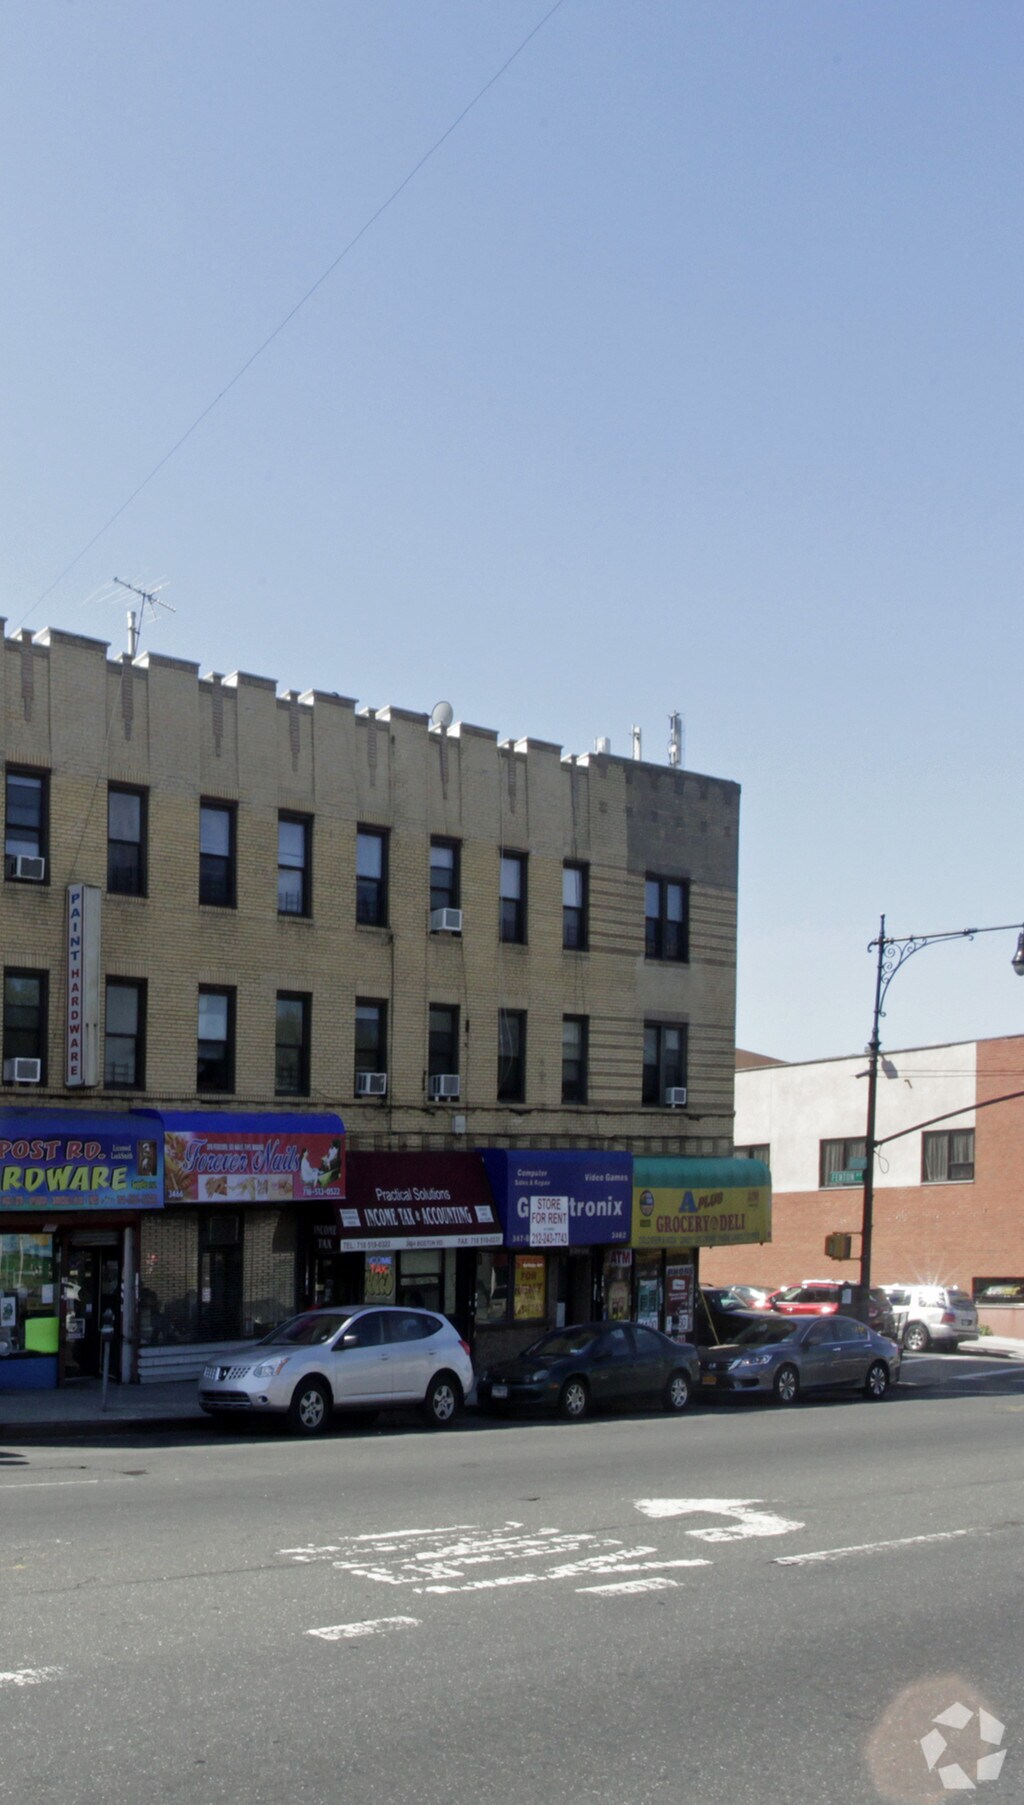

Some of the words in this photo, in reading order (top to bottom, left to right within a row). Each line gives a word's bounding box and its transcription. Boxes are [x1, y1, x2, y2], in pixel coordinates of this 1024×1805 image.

[70, 893, 80, 961] PAINT
[70, 969, 80, 1076] HARDWARE
[66, 1140, 106, 1160] RD.
[182, 1138, 248, 1173] Forever
[252, 1138, 300, 1173] Nails
[517, 1169, 548, 1179] Computer
[585, 1173, 604, 1182] Video
[605, 1173, 628, 1182] Games
[376, 1188, 412, 1201] Practical
[413, 1187, 451, 1201] Solutions
[679, 1190, 697, 1213] A
[537, 1198, 561, 1210] STORE
[364, 1208, 398, 1227] INCOME
[398, 1207, 416, 1226] TAX
[421, 1206, 473, 1225] ACCOUNTING
[532, 1212, 546, 1224] FOR
[548, 1212, 567, 1224] RENT
[656, 1215, 709, 1232] GROCERY
[719, 1213, 745, 1231] DELI
[611, 1250, 631, 1265] ATM
